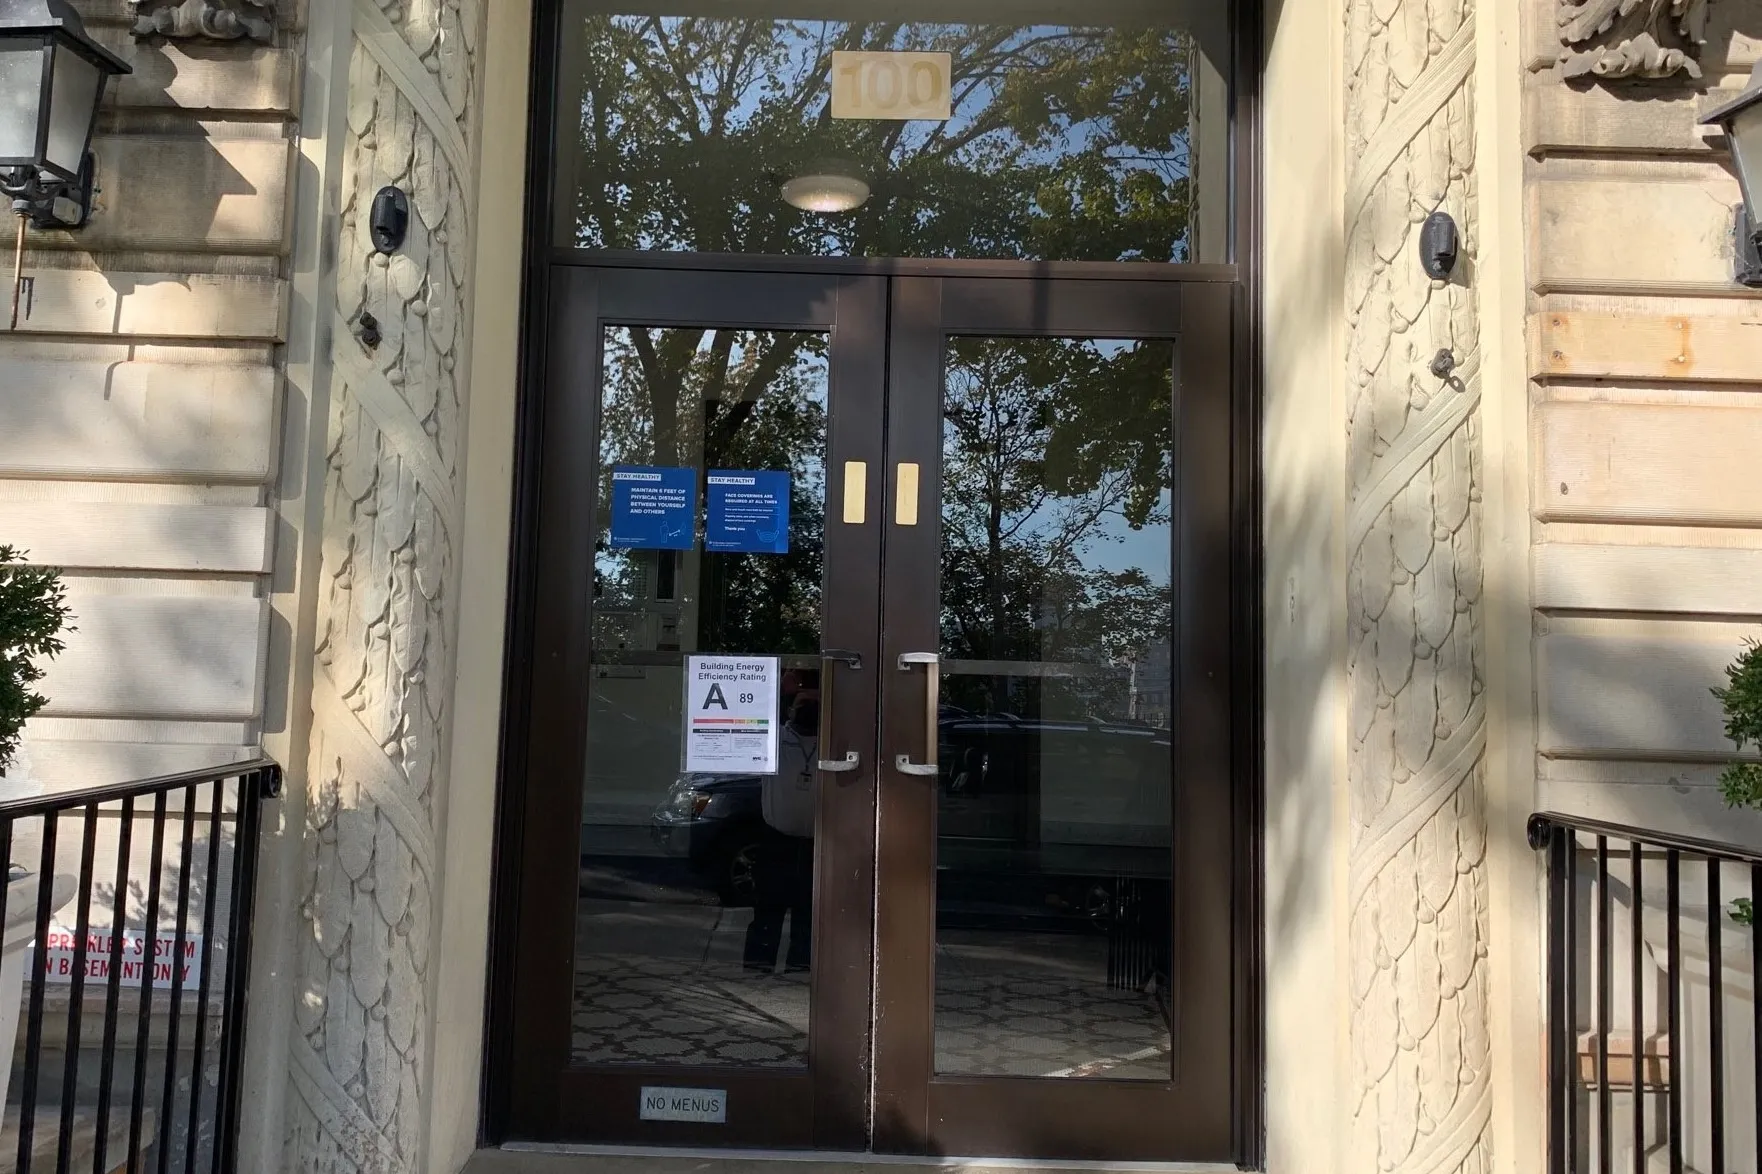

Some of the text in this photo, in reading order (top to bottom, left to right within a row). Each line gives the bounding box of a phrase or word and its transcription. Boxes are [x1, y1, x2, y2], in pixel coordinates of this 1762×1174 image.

[840, 60, 943, 109] 100
[698, 672, 767, 682] Efficiency Rating
[700, 662, 765, 672] Building Energy
[702, 682, 754, 710] A 89
[134, 938, 195, 958] SSTM
[59, 958, 144, 979] BSEMNT
[150, 963, 191, 982] ONY
[646, 1096, 720, 1113] NO MENUS
